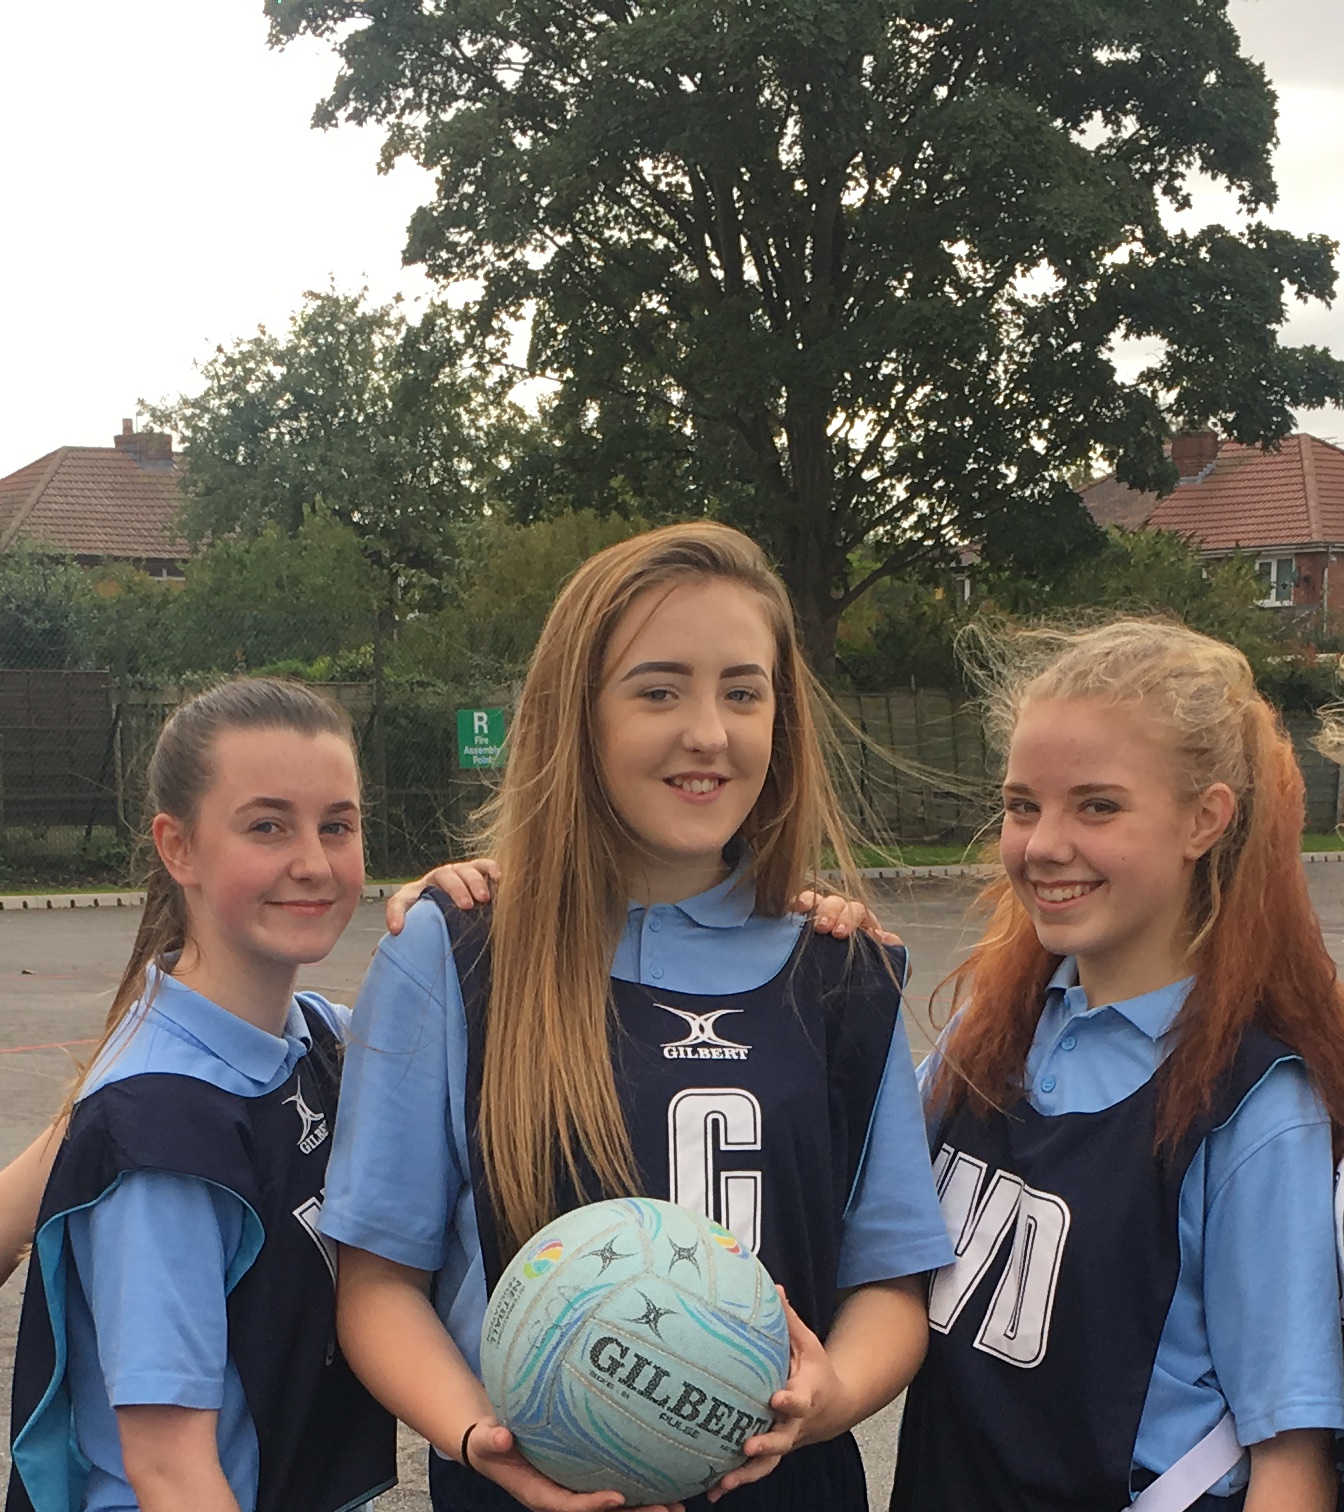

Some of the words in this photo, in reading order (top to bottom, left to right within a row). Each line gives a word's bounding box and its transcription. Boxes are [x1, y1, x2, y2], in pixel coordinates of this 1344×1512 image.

[473, 712, 489, 734] R
[474, 735, 489, 745] Fire
[663, 1046, 749, 1060] GILBERT
[668, 1088, 762, 1258] C
[928, 1142, 1071, 1369] WD
[589, 1336, 769, 1447] GILBERT
[659, 1412, 701, 1439] PULSE
